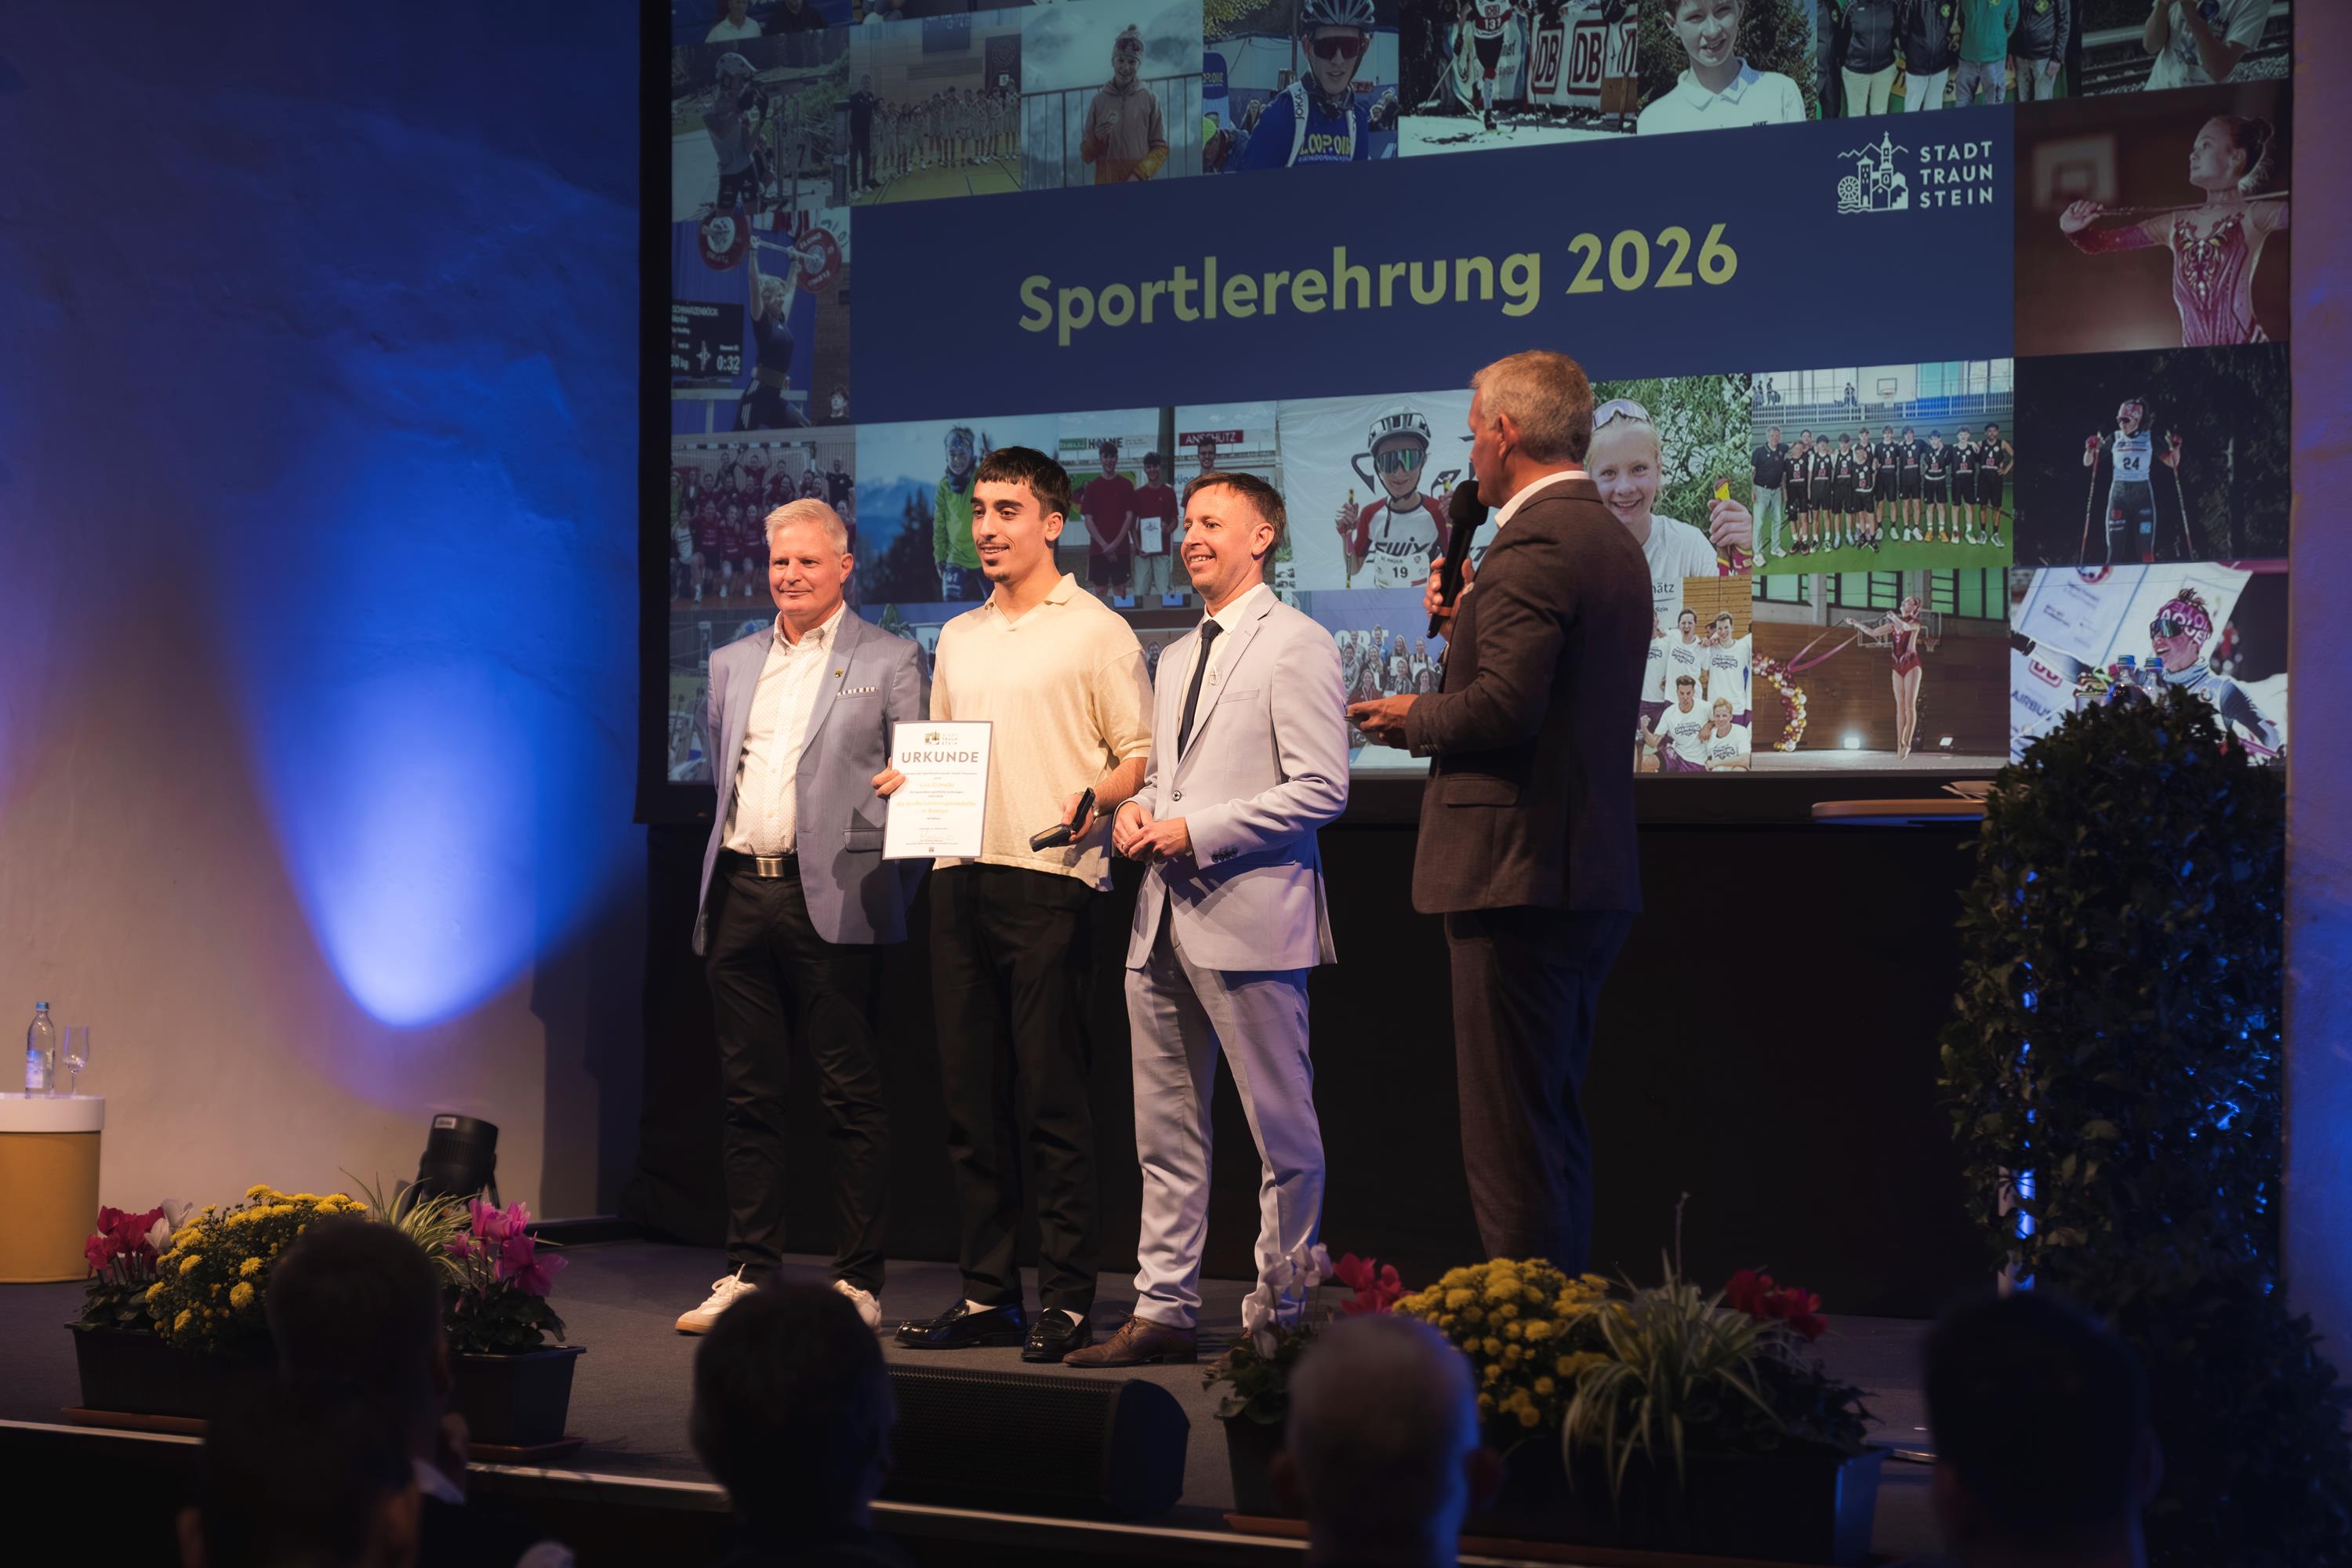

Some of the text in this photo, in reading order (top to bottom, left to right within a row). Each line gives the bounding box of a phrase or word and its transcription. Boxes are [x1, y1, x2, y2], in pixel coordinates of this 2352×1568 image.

[1484, 17, 1501, 30] 131
[1535, 34, 1559, 82] DB
[1573, 32, 1602, 83] DB
[1920, 140, 1993, 163] STADT
[1920, 163, 1993, 185] TRAUN
[1920, 187, 1993, 209] STEIN
[1018, 223, 1737, 347] Sportlerehrung 2026
[717, 354, 741, 372] 0:32
[2123, 456, 2140, 470] 24
[1392, 566, 1408, 578] 19
[901, 751, 979, 764] URKUNDE
